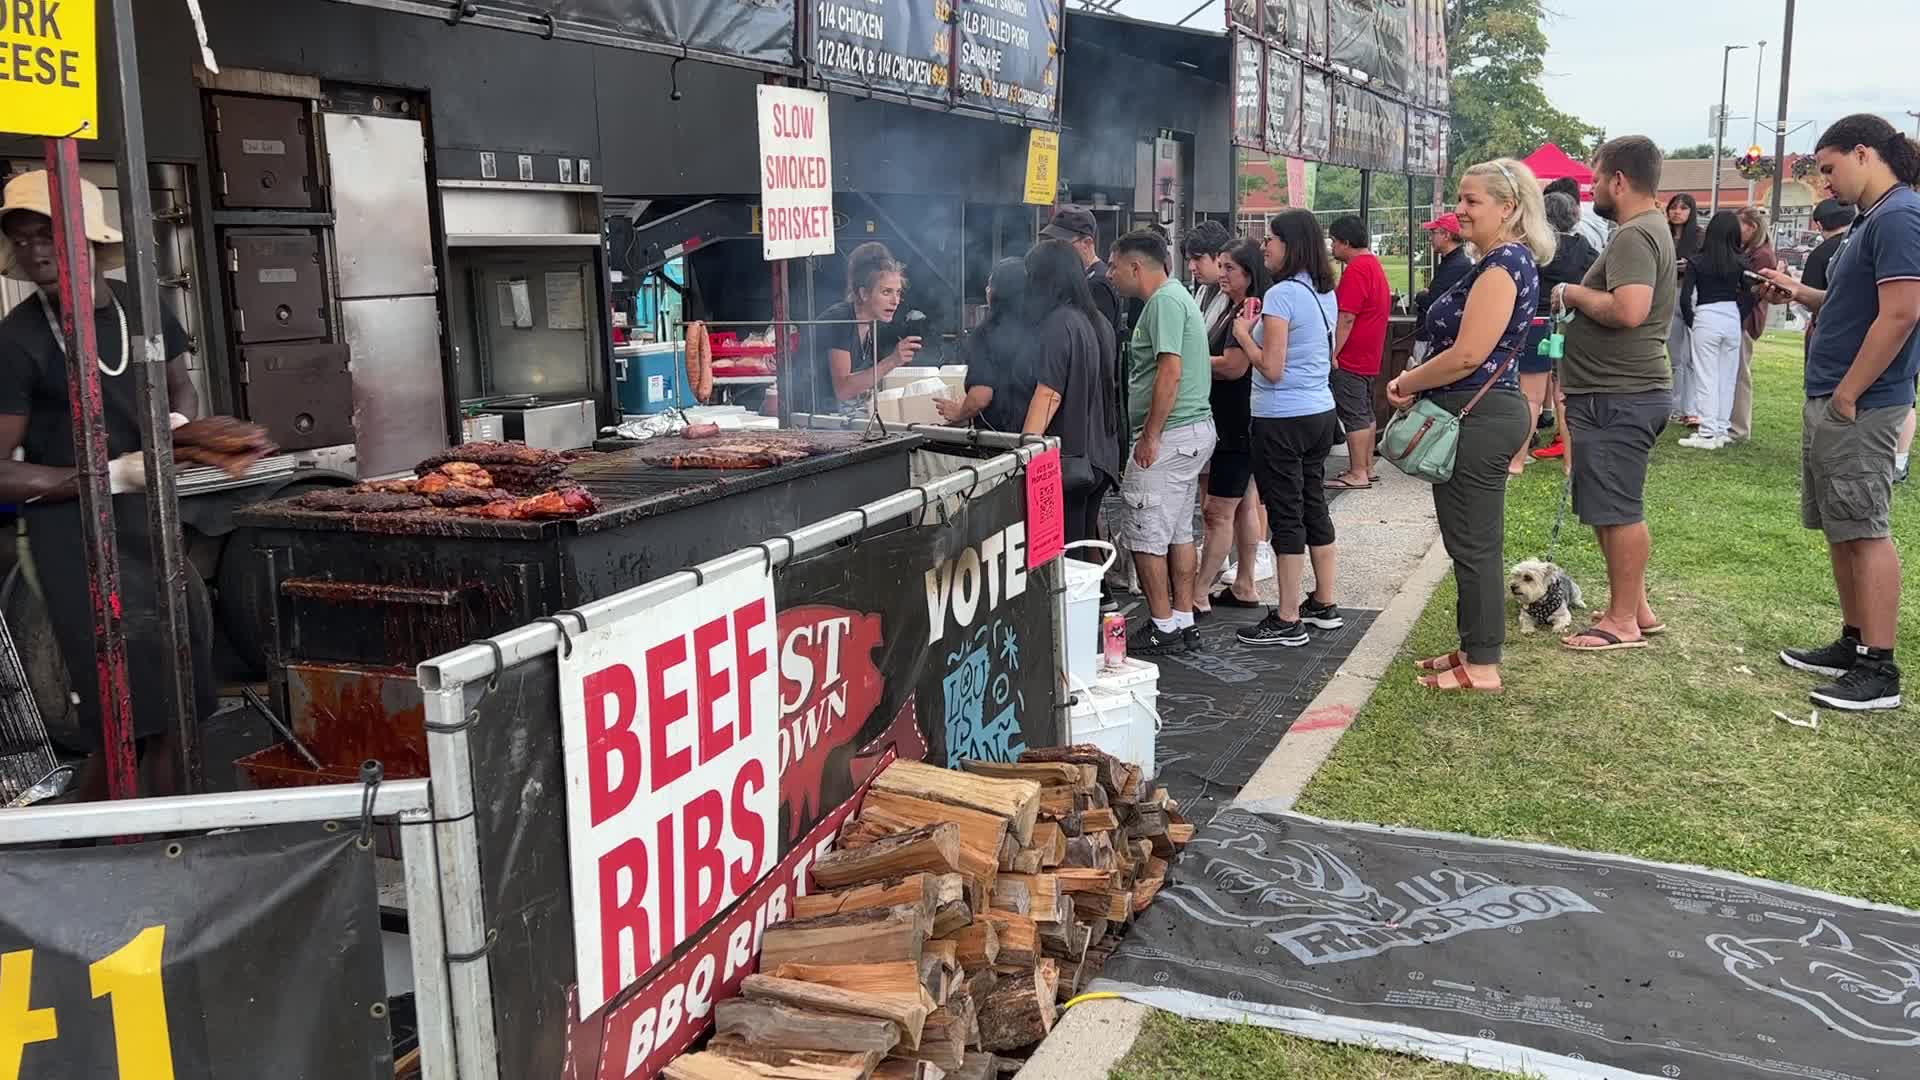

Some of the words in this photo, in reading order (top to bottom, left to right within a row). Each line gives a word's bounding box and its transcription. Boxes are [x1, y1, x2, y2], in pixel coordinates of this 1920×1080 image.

[818, 2, 835, 29] 1/4
[838, 6, 884, 41] CHICKEN
[963, 10, 980, 35] 1LB
[980, 16, 1011, 44] PULLED
[1011, 26, 1031, 50] PORK
[817, 40, 835, 67] 1/2
[836, 43, 866, 77] RACK
[867, 50, 876, 75] &
[878, 52, 891, 77] 1/4
[892, 56, 931, 86] CHICKEN
[962, 42, 1002, 72] SAUSAGE
[992, 81, 1010, 99] SLAW
[773, 103, 814, 140] SLOW
[766, 156, 827, 190] SMOKED
[768, 206, 829, 241] BRISKET
[925, 521, 1028, 646] VOTE
[582, 596, 768, 828] BEEF
[599, 758, 767, 1001] RIBS
[625, 953, 717, 1079] BBQ
[723, 883, 788, 984] RIB
